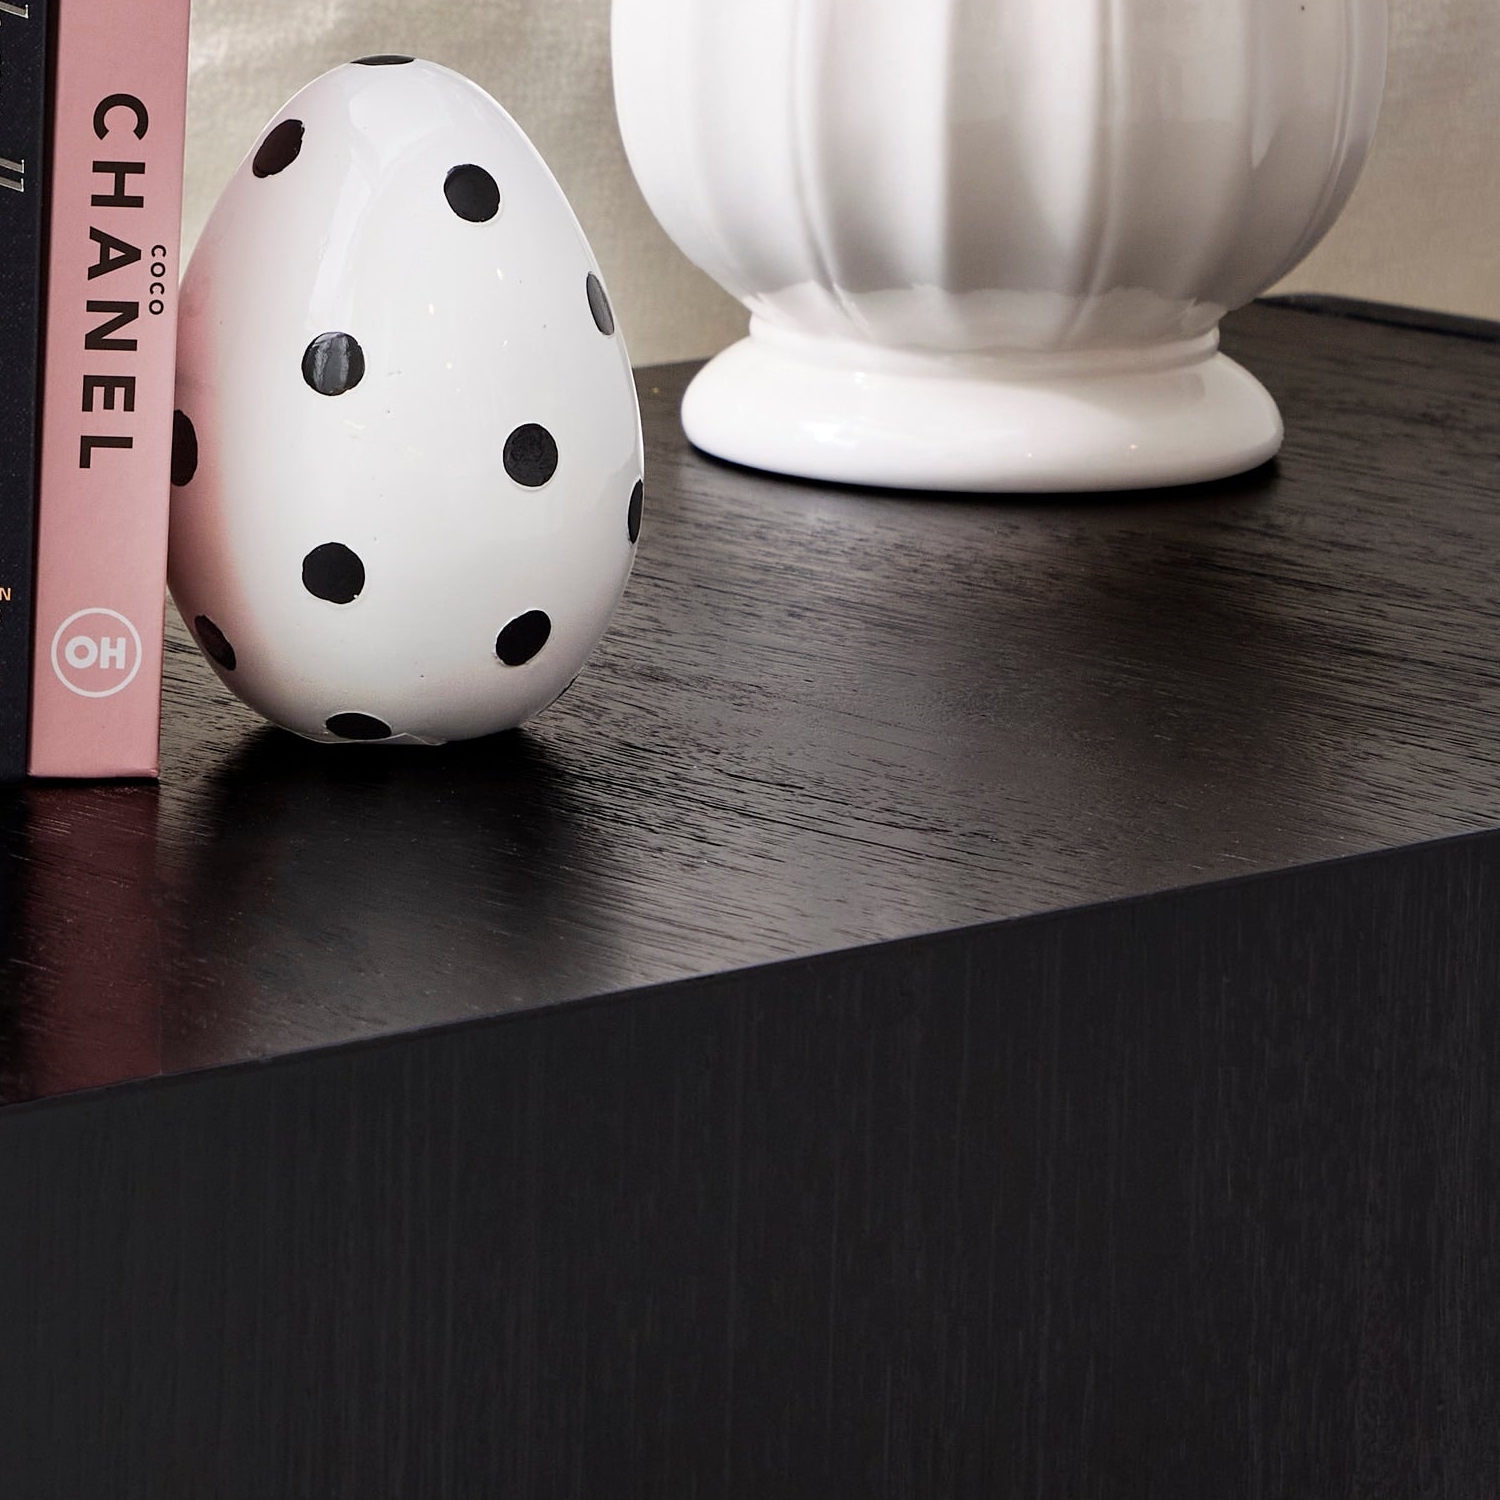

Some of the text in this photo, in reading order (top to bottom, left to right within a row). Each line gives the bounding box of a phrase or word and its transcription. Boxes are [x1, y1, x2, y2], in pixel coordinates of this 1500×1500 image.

[78, 92, 150, 470] CHANEL
[147, 243, 168, 316] COCO
[64, 635, 127, 670] OH
